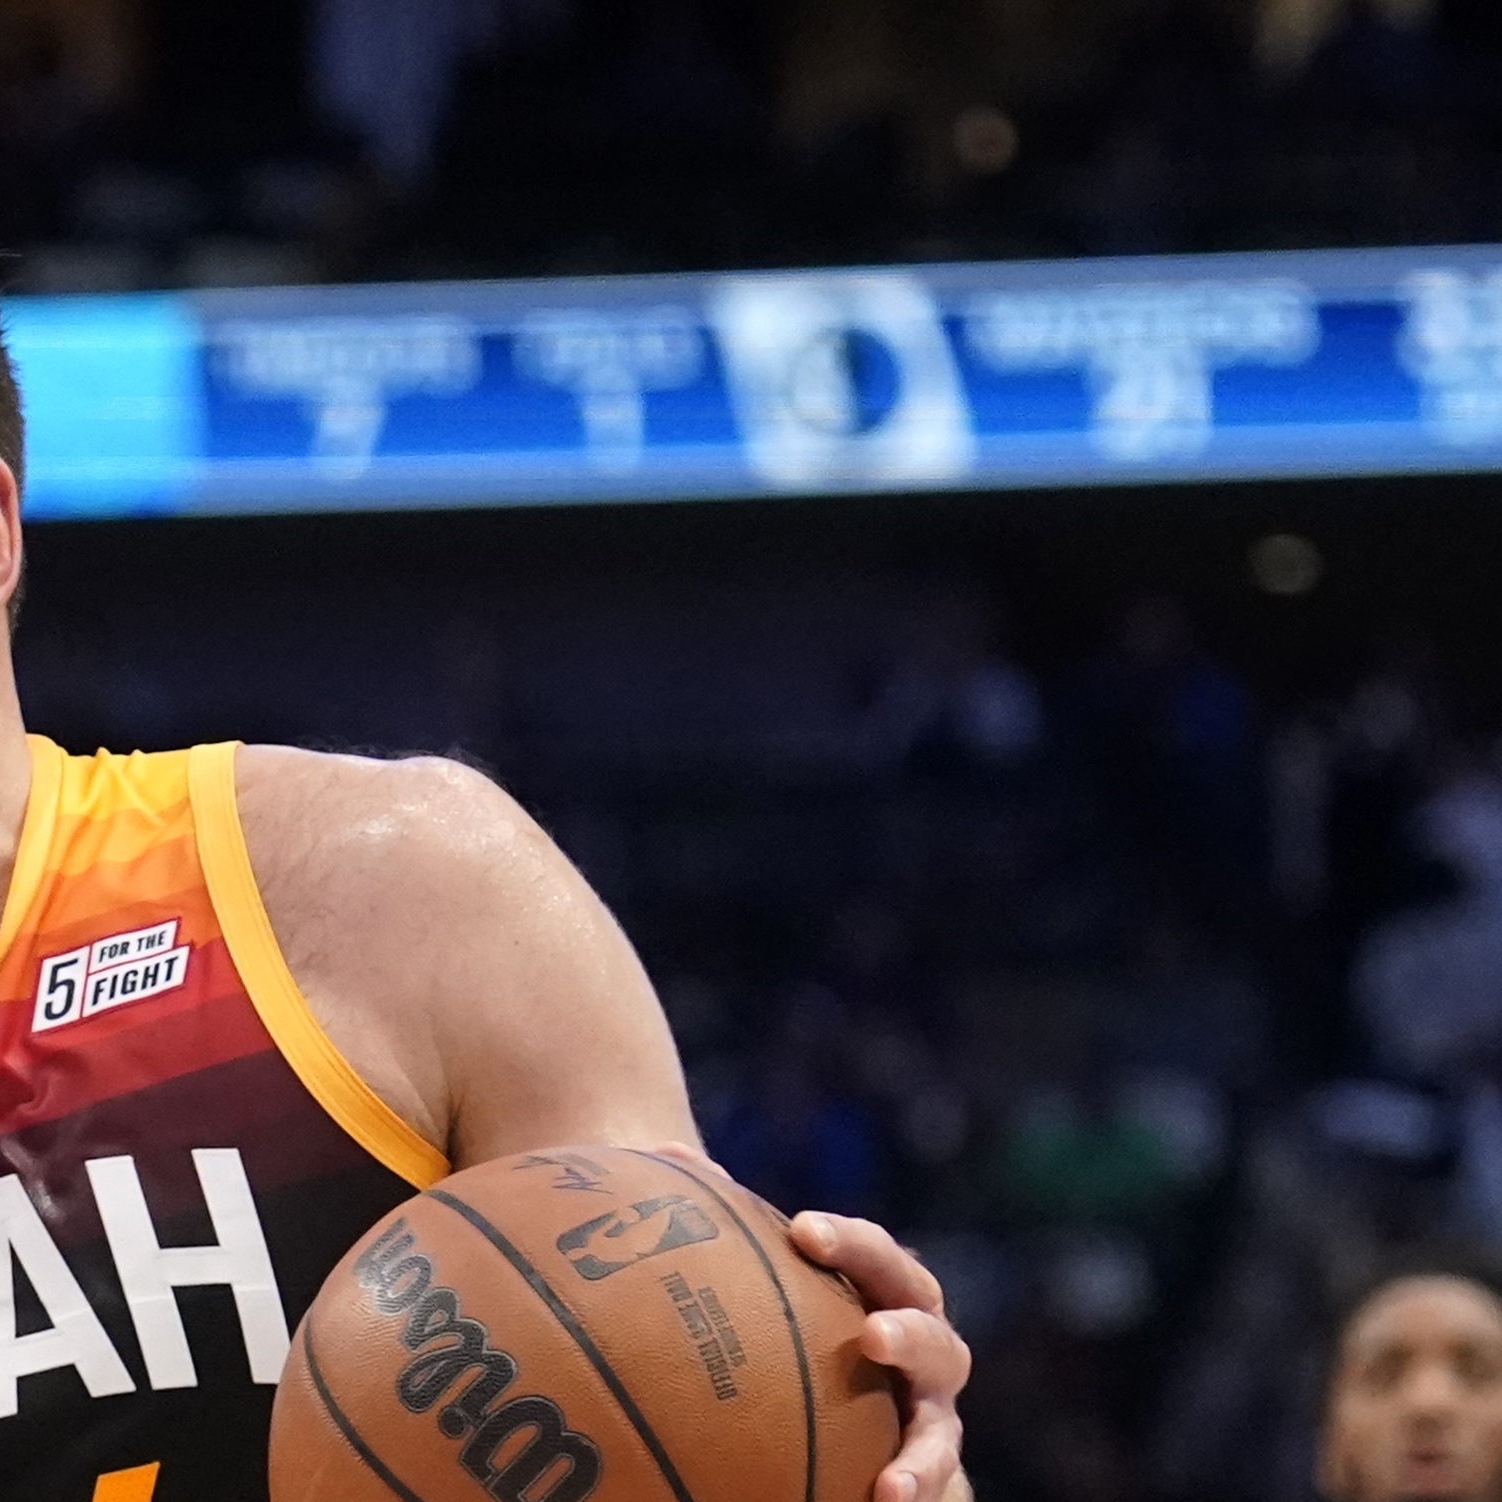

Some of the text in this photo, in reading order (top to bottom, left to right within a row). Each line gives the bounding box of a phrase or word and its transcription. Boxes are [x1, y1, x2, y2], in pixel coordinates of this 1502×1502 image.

[43, 929, 168, 1021] 5 FOR THE
[91, 955, 180, 1007] FIGHT
